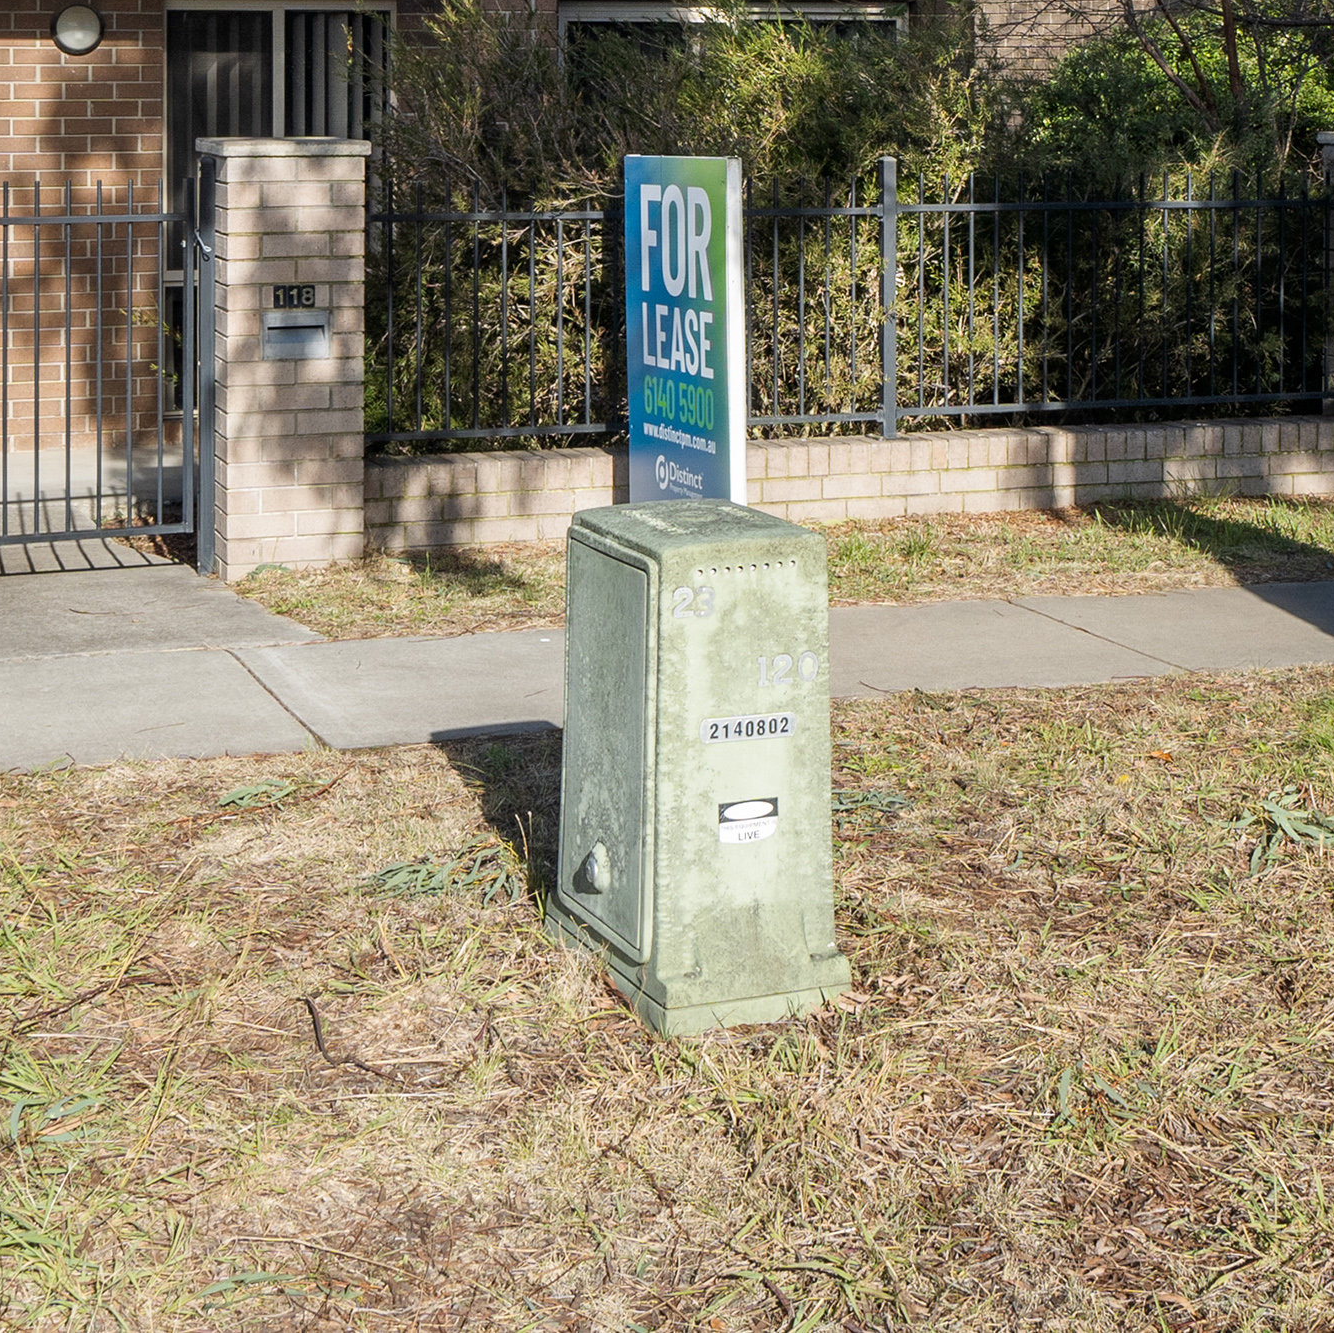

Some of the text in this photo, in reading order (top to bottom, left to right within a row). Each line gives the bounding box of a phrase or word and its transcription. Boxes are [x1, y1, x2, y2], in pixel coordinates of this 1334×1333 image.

[640, 183, 713, 301] FOR
[275, 287, 314, 305] 118
[641, 302, 714, 379] LEASE
[644, 374, 714, 430] 6140 5900
[643, 422, 716, 454] www.distinctpm.com.au
[669, 461, 703, 490] Distinct
[672, 586, 715, 618] 23
[757, 650, 818, 687] 120
[709, 716, 789, 739] 2140802
[738, 830, 760, 841] LIVE
